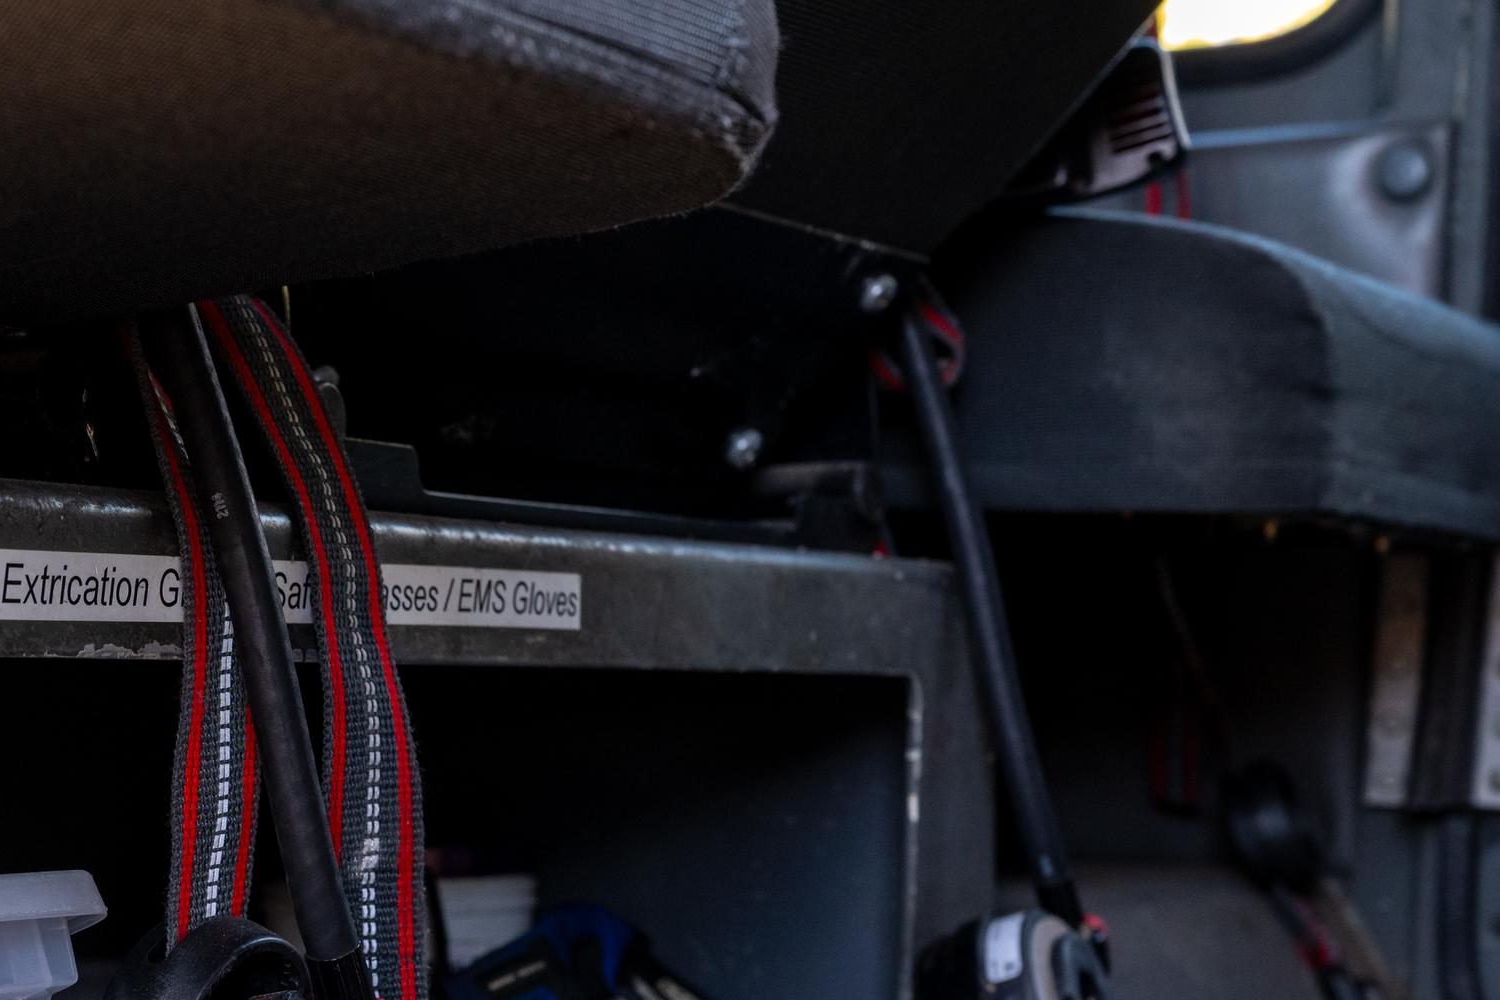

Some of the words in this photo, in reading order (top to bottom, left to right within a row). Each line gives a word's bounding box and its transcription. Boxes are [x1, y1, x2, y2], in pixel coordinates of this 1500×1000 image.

[1, 562, 149, 607] Extrication
[275, 571, 311, 610] Saf
[382, 583, 439, 612] asses
[443, 577, 455, 611] /
[457, 579, 506, 614] EMS
[512, 581, 579, 617] Gloves
